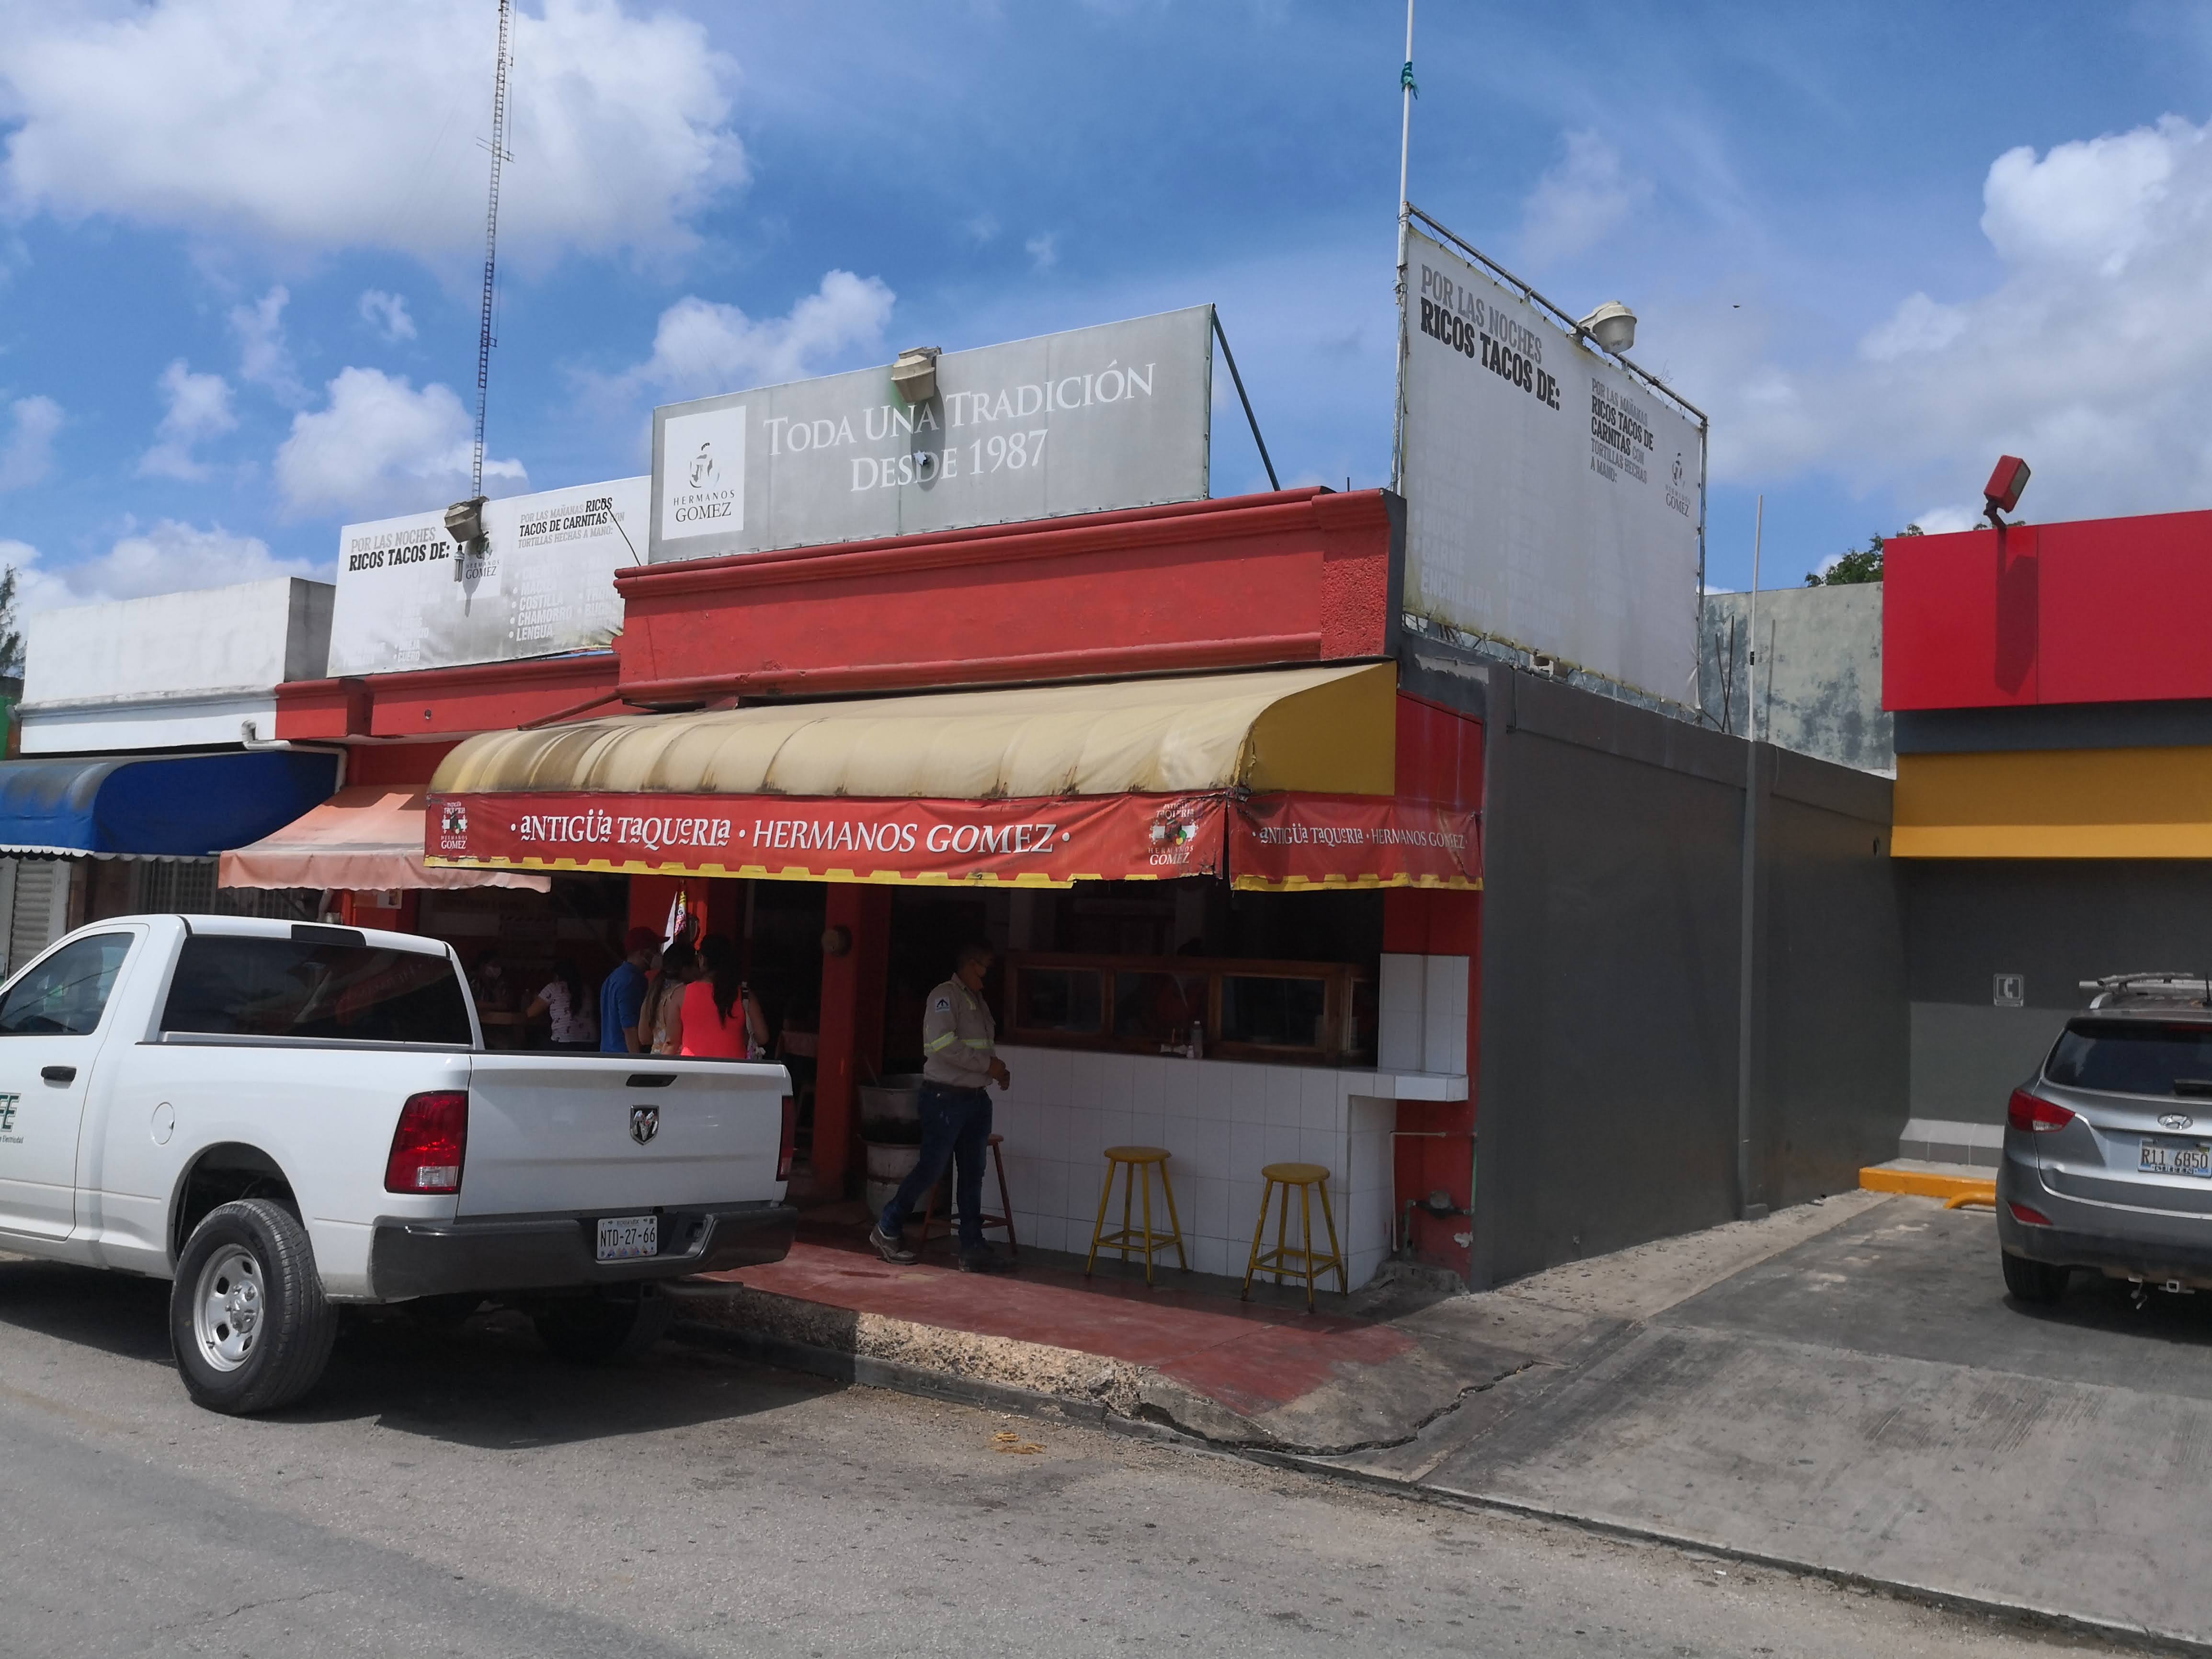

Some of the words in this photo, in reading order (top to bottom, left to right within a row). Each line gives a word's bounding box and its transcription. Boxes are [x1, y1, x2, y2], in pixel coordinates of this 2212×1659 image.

[1421, 264, 1453, 309] POR
[1458, 286, 1484, 328] LAS
[1489, 306, 1542, 364] NOCHES
[1421, 296, 1475, 358] RICOS
[1480, 331, 1533, 393] TACOS
[1537, 367, 1560, 411] DE:
[1592, 378, 1605, 398] POR
[1607, 387, 1618, 407] LAS
[764, 415, 857, 455] TODA
[863, 402, 939, 439] UNA
[946, 359, 1156, 428] TRADICIÓN
[1592, 395, 1616, 426] RICOS
[1618, 410, 1642, 443] TACOS
[1644, 429, 1653, 452] DE
[1591, 417, 1630, 456] CARNITAS
[1632, 446, 1644, 466] CON
[849, 447, 957, 492] DESDE
[970, 429, 1049, 475] 1987
[1590, 456, 1595, 471] A
[1591, 438, 1623, 469] TORTILLAS
[1624, 458, 1647, 485] HECHAS
[673, 489, 735, 506] HERMANOS
[1666, 493, 1689, 517] GOMEZ
[521, 513, 534, 523] POR
[536, 510, 548, 521] LAS
[550, 504, 583, 518] MAÑANAS
[585, 497, 613, 513] RICOS
[676, 502, 731, 522] GOMEZ
[520, 522, 547, 537] TACOS
[549, 519, 561, 532] DE
[563, 512, 608, 530] CARNITAS
[351, 537, 371, 553] POR
[374, 534, 392, 549] LAS
[395, 527, 436, 546] NOCHES
[518, 534, 552, 548] TORTILLAS
[554, 529, 582, 543] HECHAS
[583, 529, 588, 538] A
[349, 550, 384, 571] RICOS
[388, 544, 426, 566] TACOS
[430, 541, 450, 560] DE:
[466, 566, 497, 580] GOMEZ
[519, 592, 564, 611] COSTILLA
[518, 605, 573, 626] CHAMORRO
[516, 624, 553, 641] LENGUA
[441, 840, 466, 849] GOMEZ
[753, 819, 917, 852] HERMANOS
[926, 824, 1057, 853] GOMEZ
[1371, 829, 1426, 846] HERMANOS
[1429, 831, 1466, 850] GOMEZ
[1148, 845, 1194, 854] HERMANOS
[1150, 852, 1190, 865] GOMEZ
[2175, 1151, 2208, 1169] 6850
[601, 1227, 655, 1247] NTD-27-66
